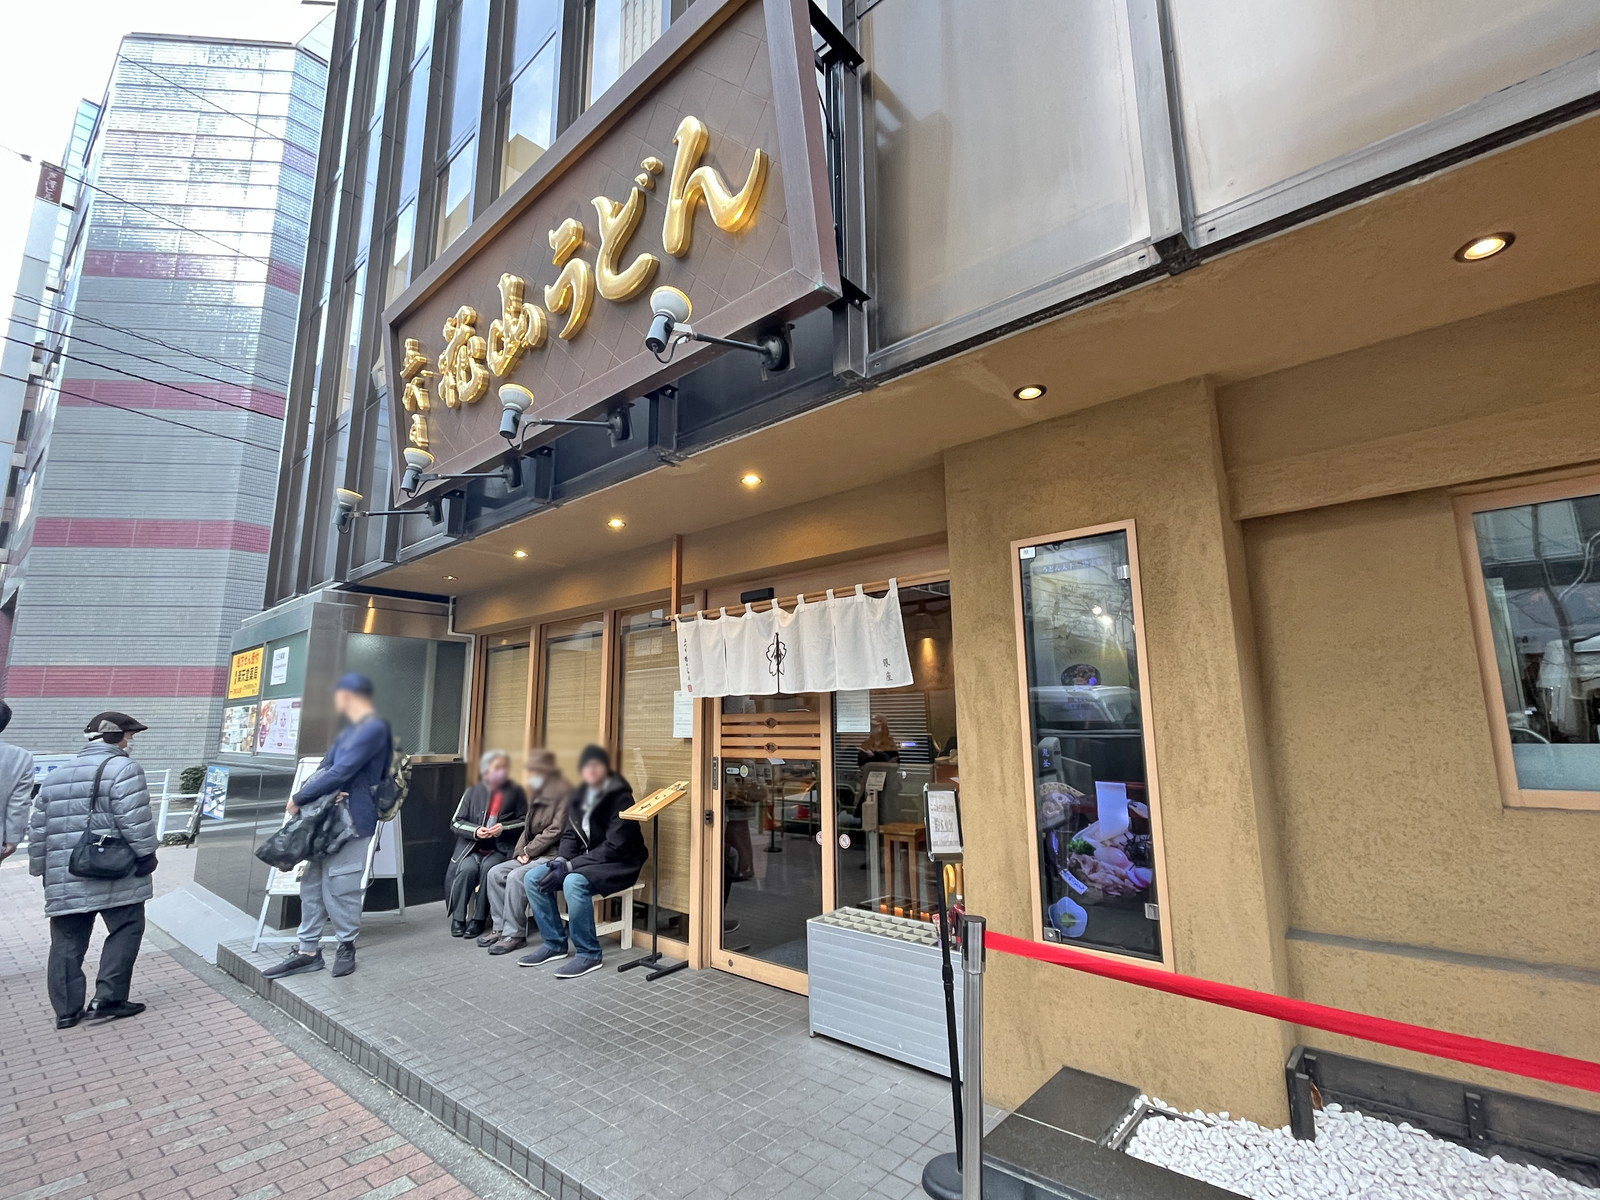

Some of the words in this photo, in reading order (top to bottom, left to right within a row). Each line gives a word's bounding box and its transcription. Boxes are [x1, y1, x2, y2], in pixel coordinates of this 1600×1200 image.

[438, 115, 768, 408] 花山うどん
[882, 657, 893, 681] 銀座
